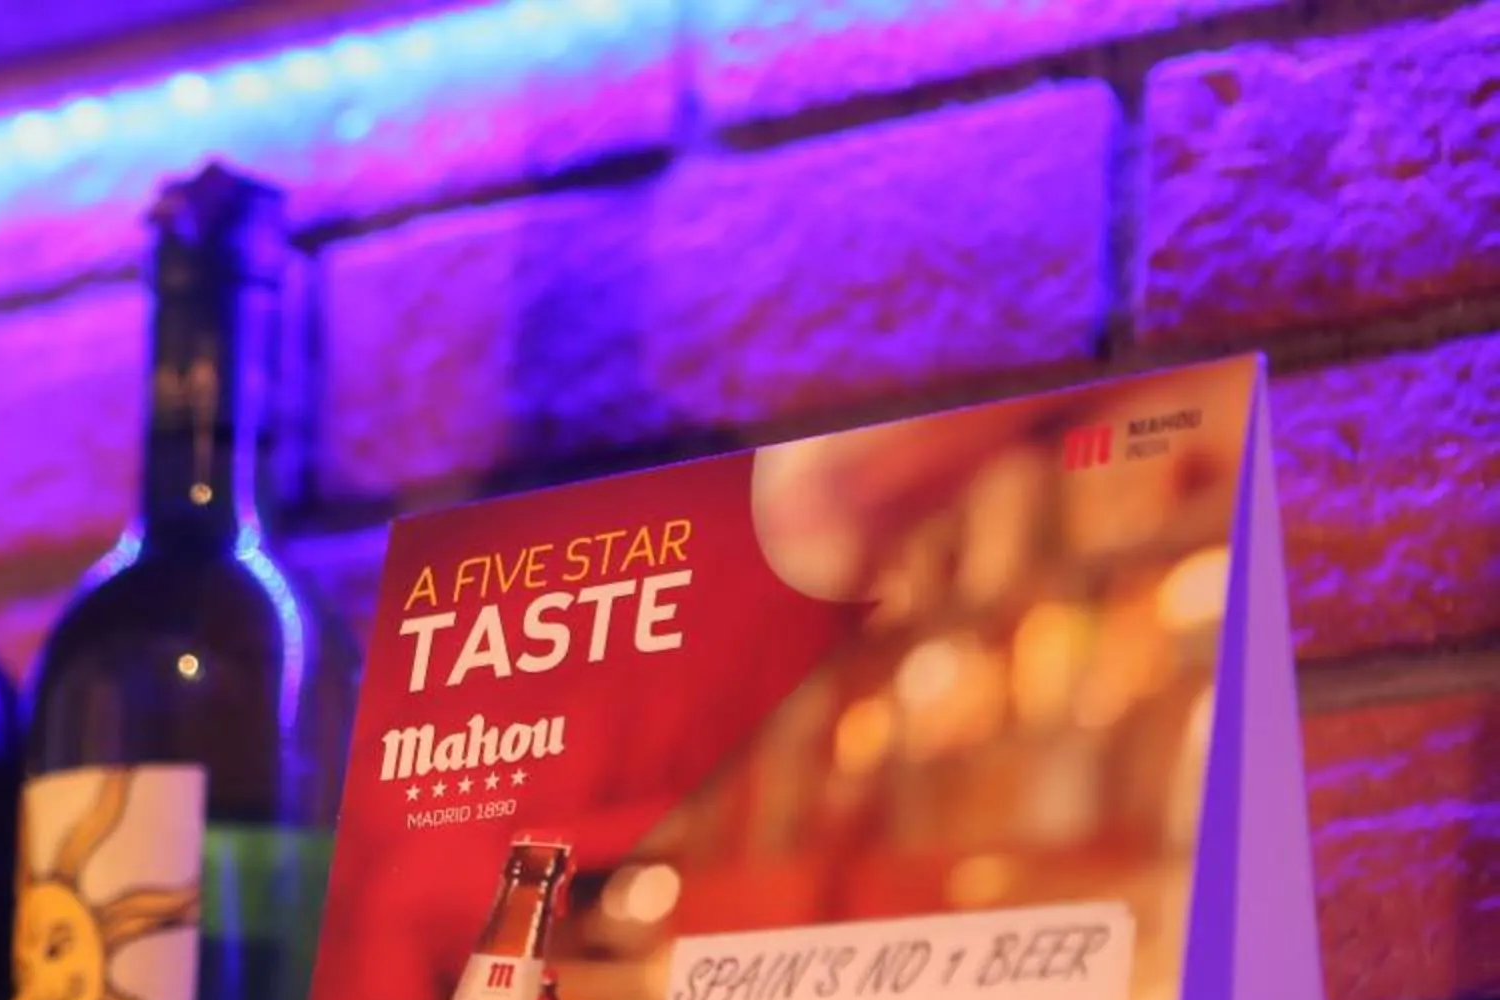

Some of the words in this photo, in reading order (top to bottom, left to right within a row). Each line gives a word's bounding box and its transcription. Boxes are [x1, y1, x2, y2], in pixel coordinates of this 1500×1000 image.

[404, 567, 437, 611] A
[453, 543, 554, 603] FIVE
[562, 519, 691, 582] STAR
[399, 569, 693, 693] TASTE
[379, 714, 566, 781] Mahou
[406, 805, 471, 830] MADRID
[476, 799, 517, 820] 1890
[854, 940, 932, 996] NO
[939, 949, 965, 985] 1
[976, 924, 1111, 988] BEER
